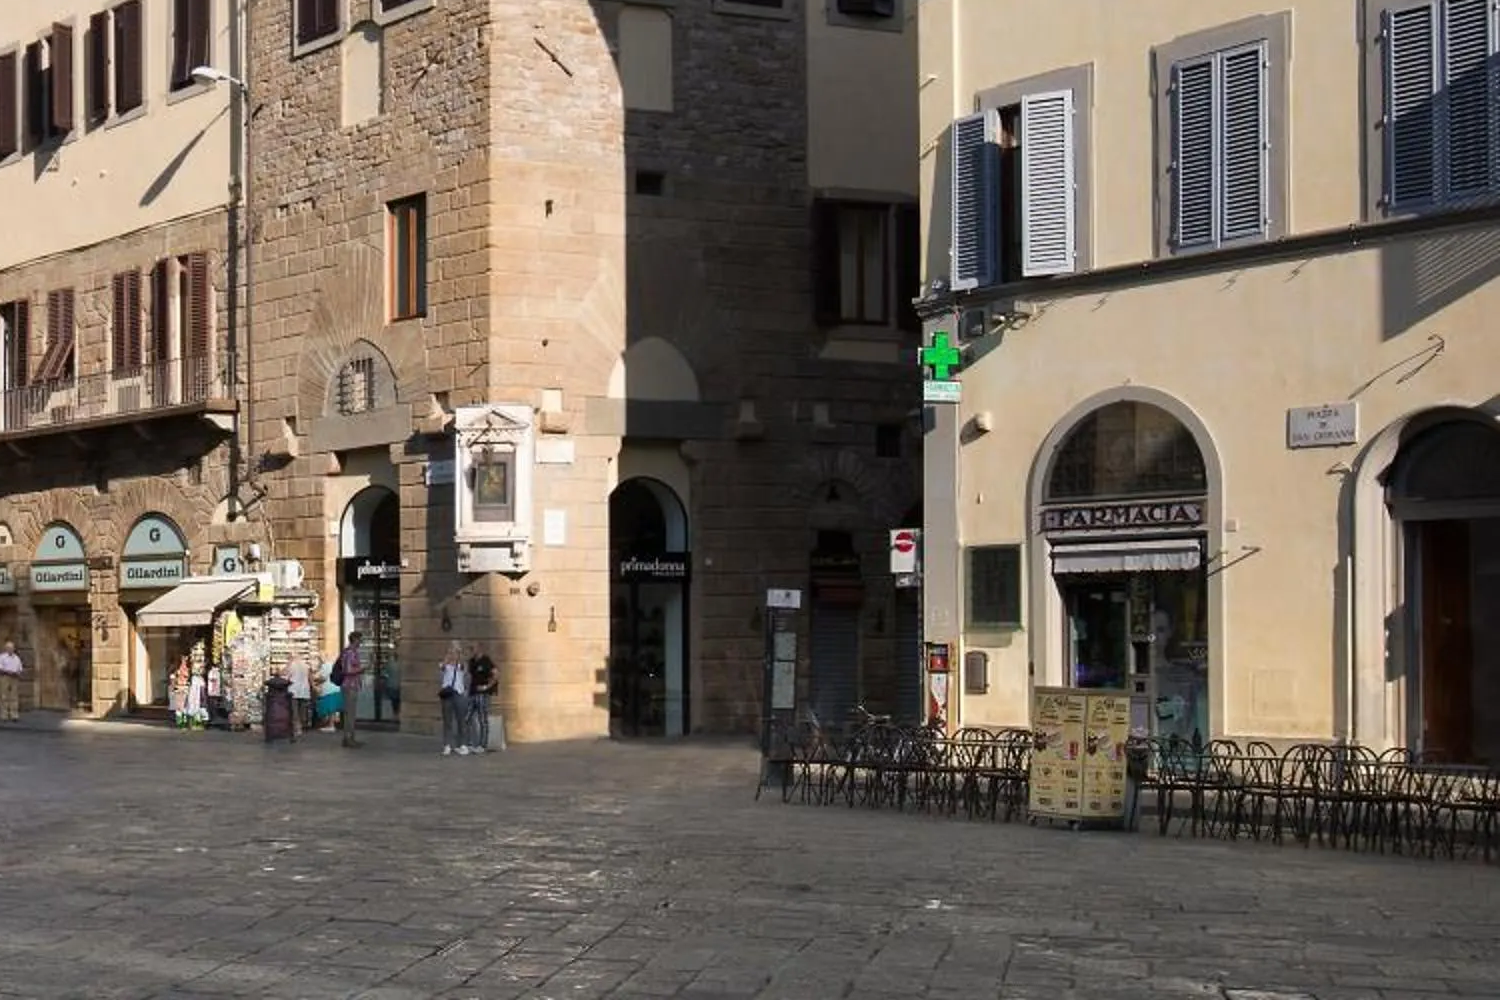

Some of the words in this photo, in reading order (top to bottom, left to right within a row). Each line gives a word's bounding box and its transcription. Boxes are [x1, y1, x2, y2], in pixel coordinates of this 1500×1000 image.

[1307, 408, 1339, 419] PIAZZA
[1059, 503, 1193, 527] FARMACIA
[55, 535, 65, 549] G
[148, 527, 161, 543] G
[127, 566, 180, 579] Gilardini
[223, 557, 236, 573] G
[621, 556, 685, 577] primadonna
[35, 570, 83, 583] Gilardini
